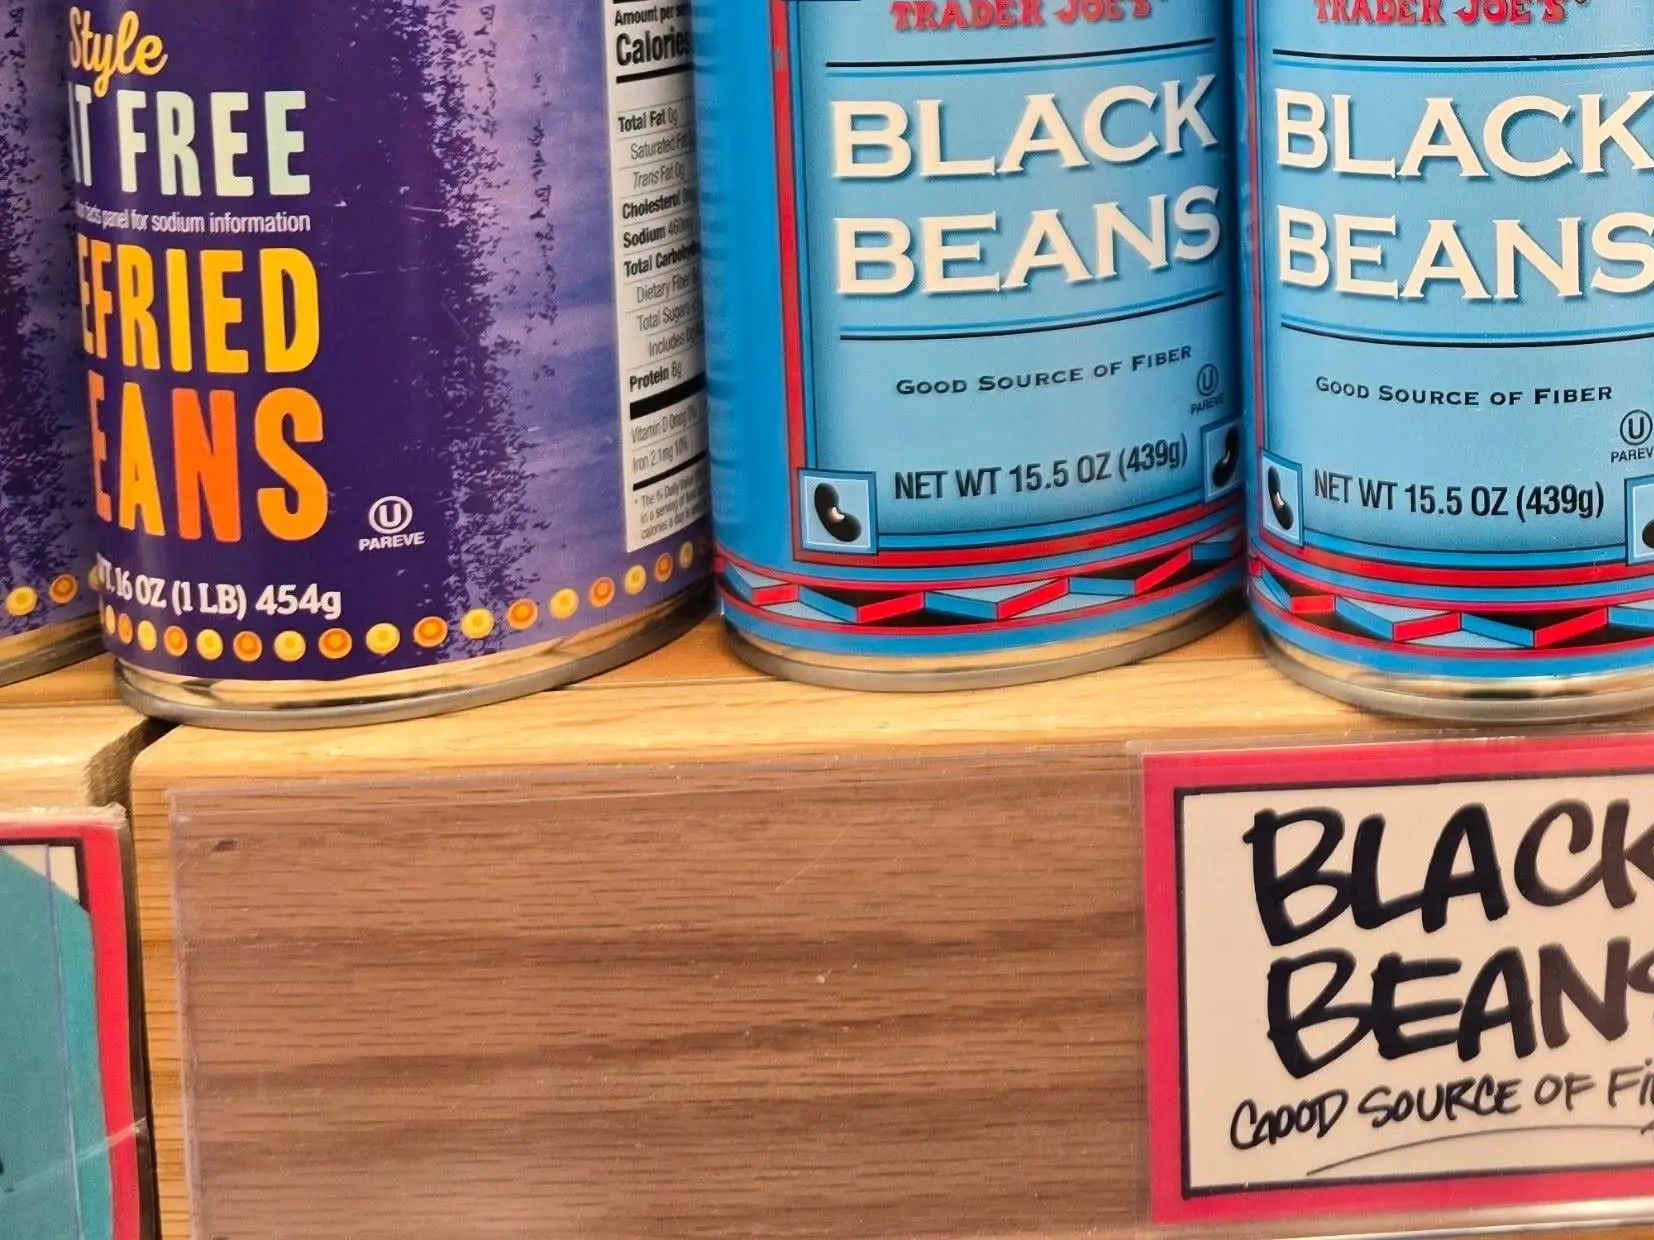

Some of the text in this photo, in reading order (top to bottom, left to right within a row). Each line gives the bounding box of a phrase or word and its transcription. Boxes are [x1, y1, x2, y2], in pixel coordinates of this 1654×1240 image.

[615, 5, 658, 26] Amount
[617, 108, 666, 133] Total Fat
[831, 74, 1219, 178] BLACK
[117, 90, 311, 197] FREE
[632, 170, 660, 189] Trans
[622, 189, 680, 219] Cholesterol
[151, 211, 205, 232] sodium
[209, 211, 311, 234] information
[623, 225, 665, 248] Sodium
[833, 185, 1221, 296] BEANS
[624, 255, 652, 277] Total
[77, 231, 319, 375] EFRIED
[636, 310, 660, 331] Total
[629, 365, 669, 392] Protein
[896, 378, 967, 396] GOOD
[978, 367, 1082, 392] SOURCE
[1131, 345, 1192, 372] FIBER
[1315, 375, 1370, 400] GOOD
[1378, 384, 1480, 406] SOURCE
[1534, 386, 1614, 405] FIBER
[88, 369, 328, 542] EANS
[895, 432, 1188, 500] NET WT 15.5 OZ (439g)
[1313, 468, 1604, 523] NET WT 15.5 OZ (439g)
[358, 531, 426, 551] PAREVE
[135, 575, 167, 608] OZ
[198, 583, 247, 621] LB)
[255, 583, 342, 621] 454g
[1229, 1085, 1347, 1151] GOOD
[1357, 1076, 1523, 1129] SOURCE
[1532, 1072, 1597, 1113] OF
